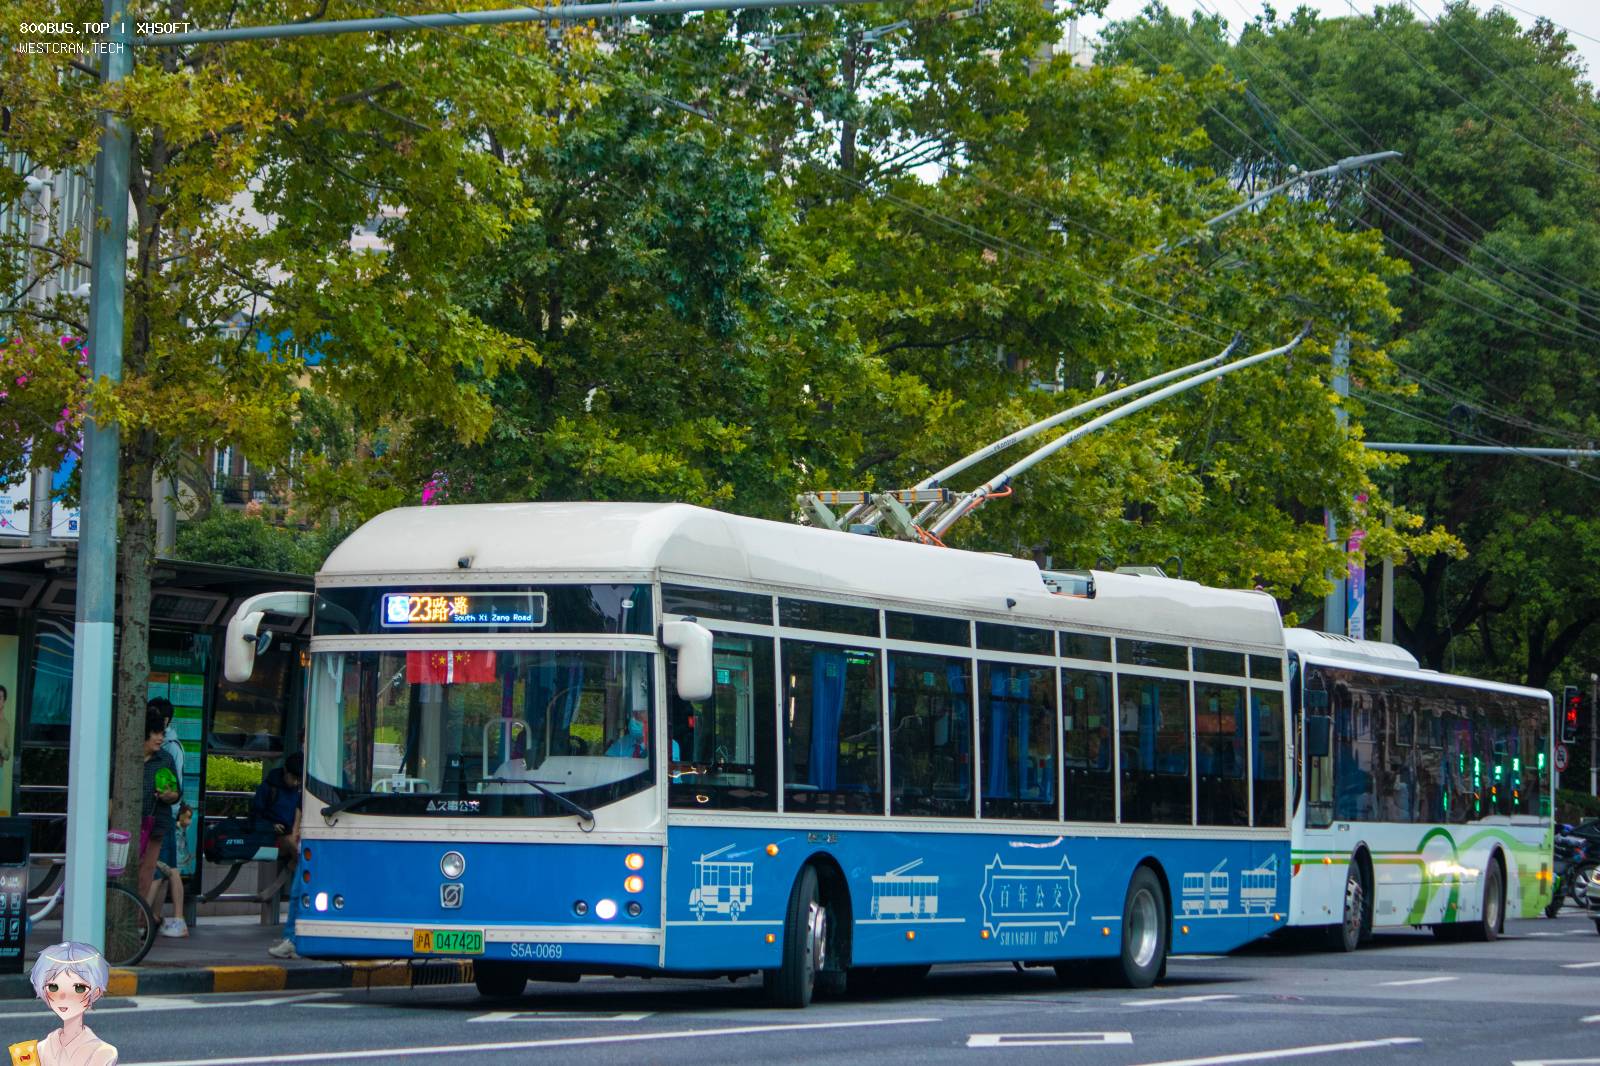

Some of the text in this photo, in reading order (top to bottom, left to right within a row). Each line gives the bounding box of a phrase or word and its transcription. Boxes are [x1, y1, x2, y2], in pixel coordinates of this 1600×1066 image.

[454, 614, 532, 622] South Xi Zang Road
[1000, 883, 1062, 909] 百年公交
[1043, 930, 1059, 945] BUS
[510, 942, 563, 959] S5A-0069
